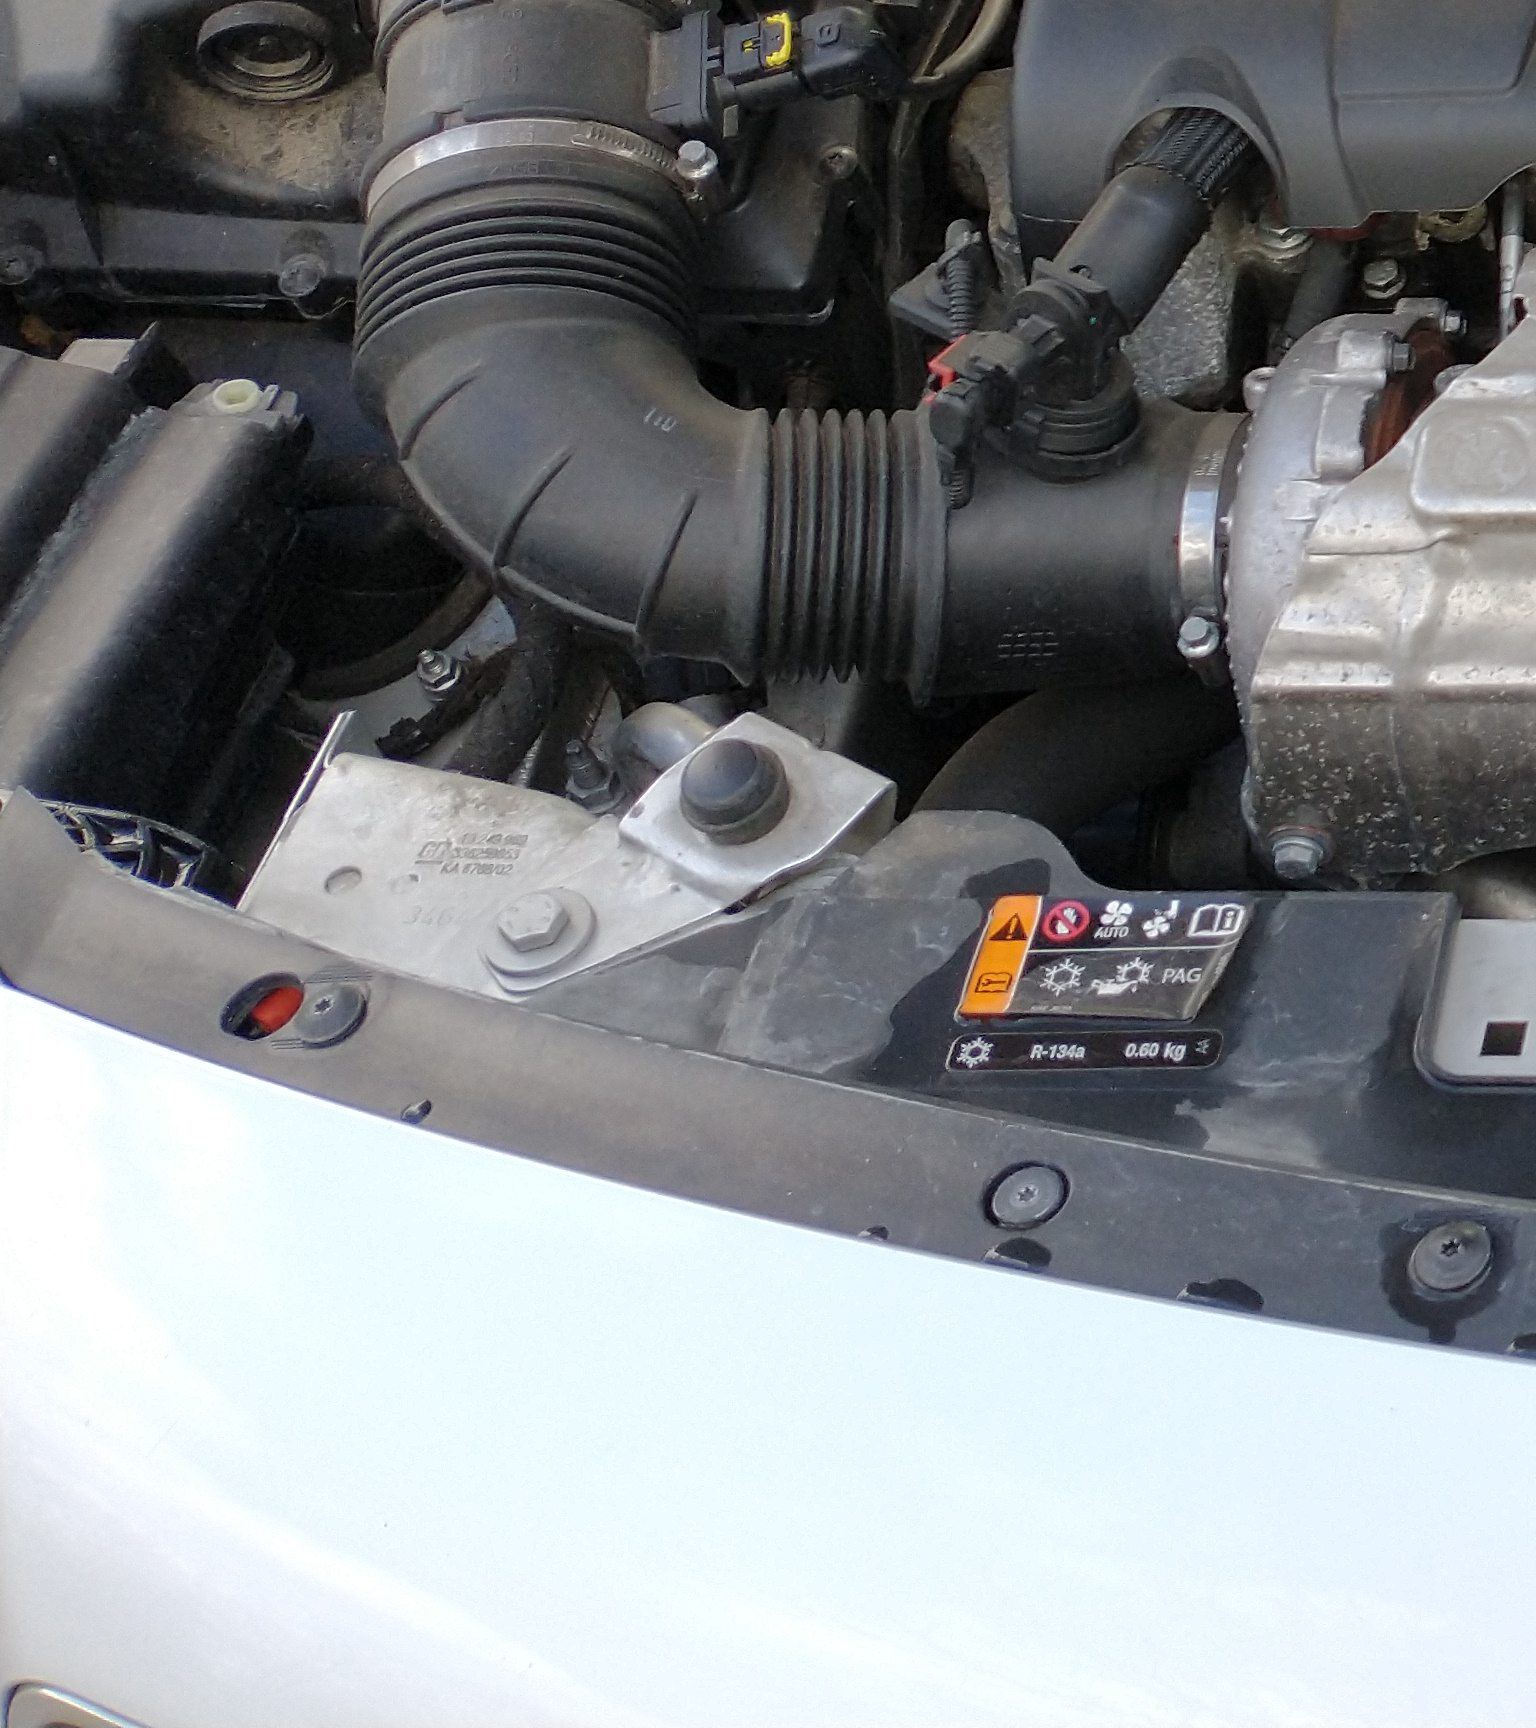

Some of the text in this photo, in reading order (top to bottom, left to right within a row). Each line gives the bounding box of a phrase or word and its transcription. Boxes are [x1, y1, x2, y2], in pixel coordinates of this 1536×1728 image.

[1094, 926, 1130, 939] AUTO
[1161, 967, 1204, 984] PAG
[1029, 1043, 1087, 1060] R-134a
[1124, 1042, 1160, 1058] 0.60
[1163, 1041, 1187, 1062] kg
